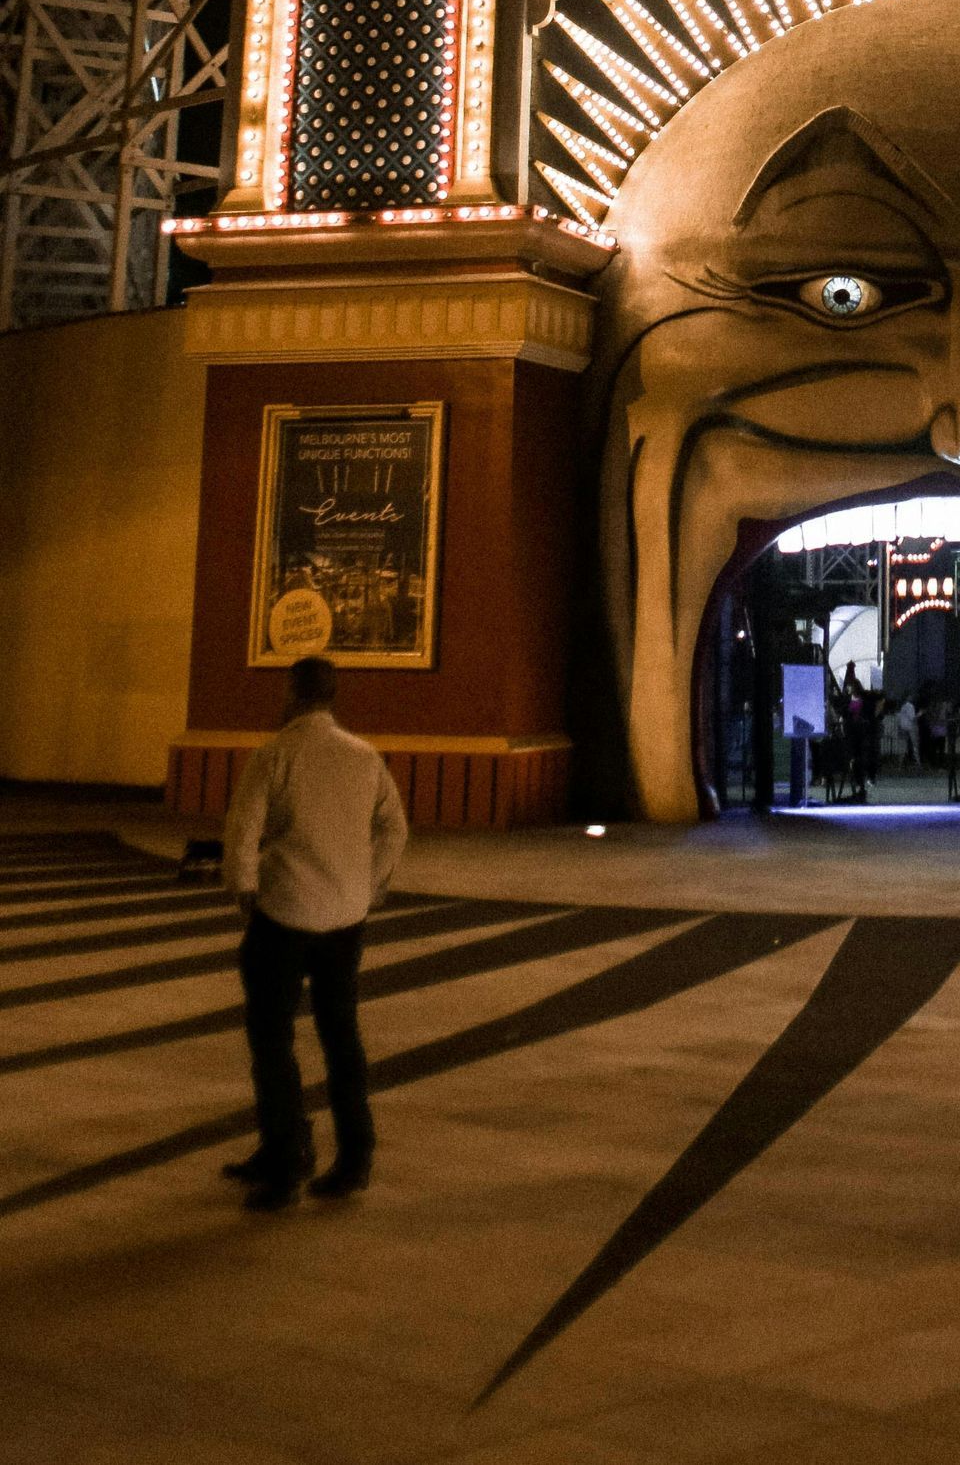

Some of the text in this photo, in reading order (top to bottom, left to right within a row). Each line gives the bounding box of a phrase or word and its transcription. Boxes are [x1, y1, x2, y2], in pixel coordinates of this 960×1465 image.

[299, 431, 412, 446] MELBOURNE'S MOST
[298, 446, 412, 460] UNIQUE FUNCTIONS!
[298, 496, 405, 526] Events
